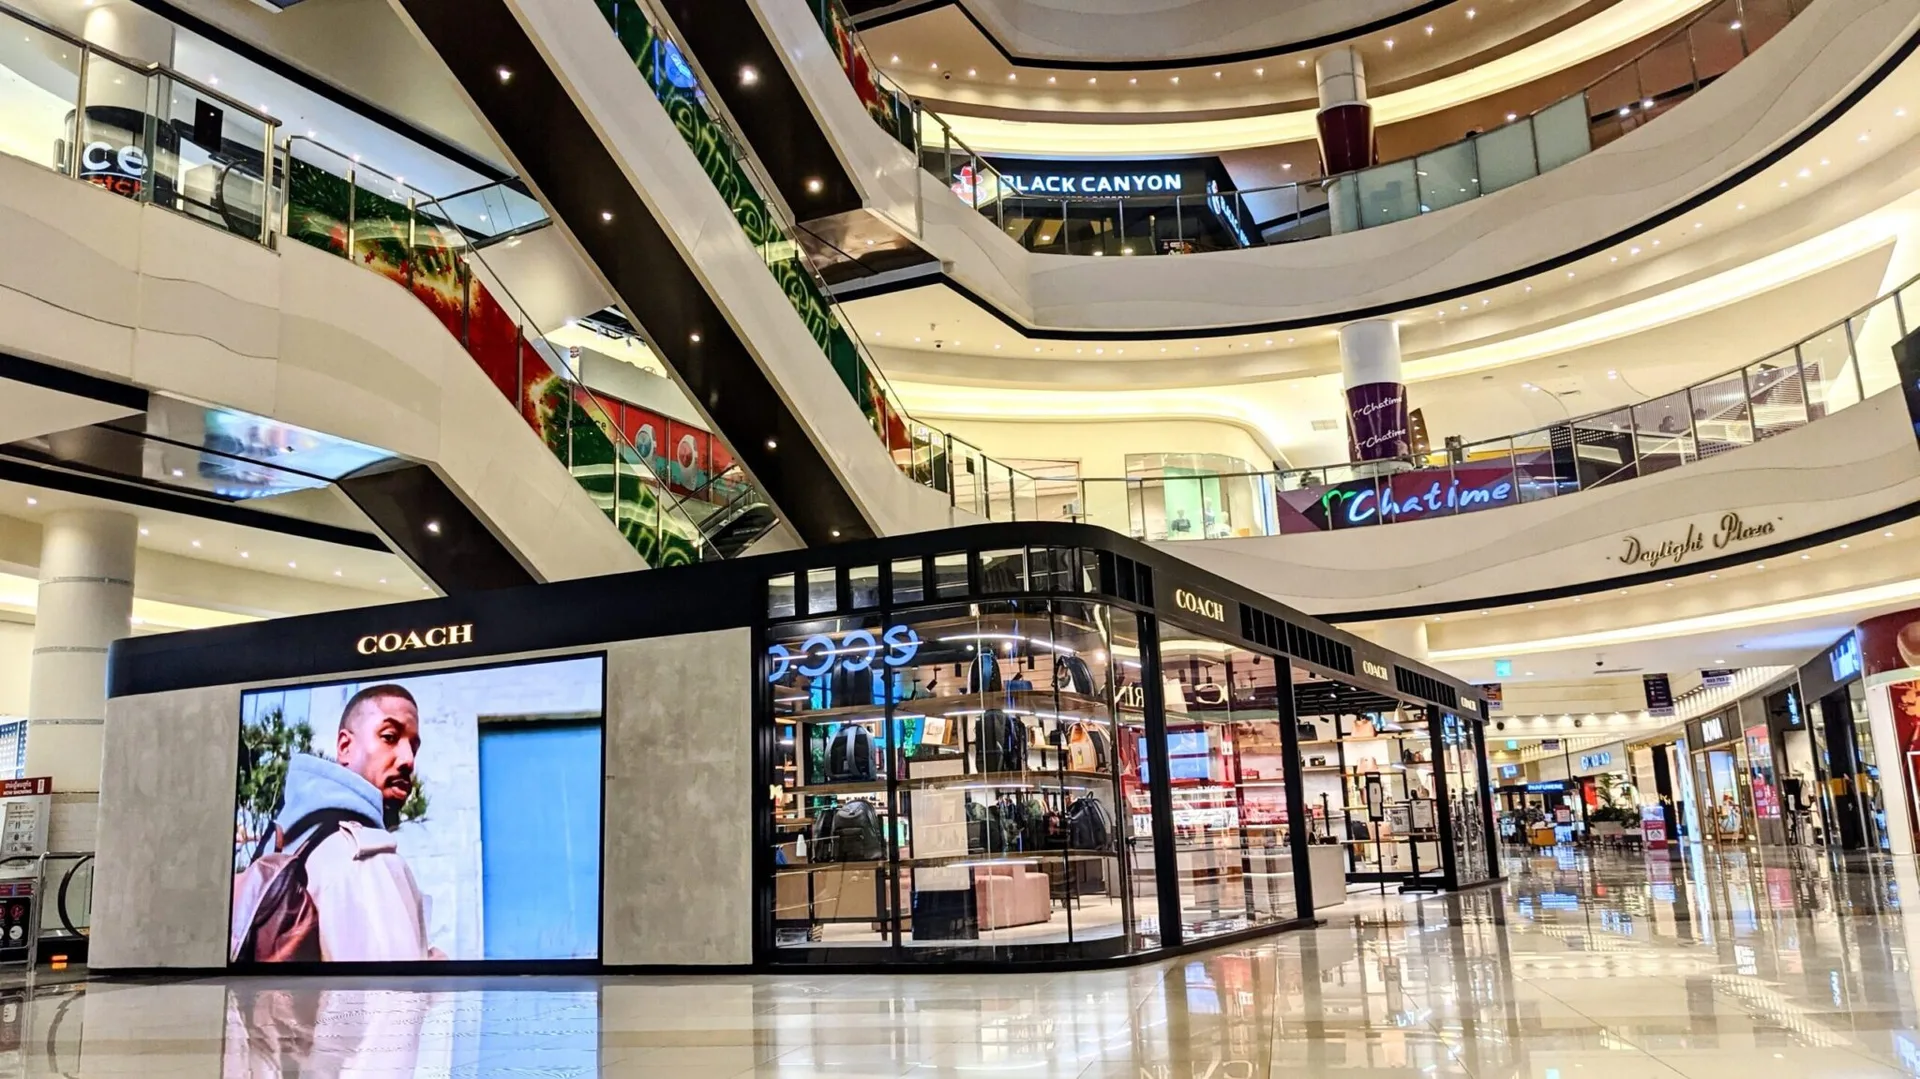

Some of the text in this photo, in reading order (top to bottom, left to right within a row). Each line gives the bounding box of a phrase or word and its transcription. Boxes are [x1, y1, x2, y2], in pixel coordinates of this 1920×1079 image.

[1000, 174, 1181, 193] BLACK CANYON
[1362, 396, 1402, 416] Chatime
[1366, 428, 1407, 448] Chatime
[1349, 479, 1511, 522] Chatime
[1619, 512, 1775, 568] Daylight Plaza
[1175, 588, 1225, 623] COACH
[357, 623, 473, 655] COACH
[1362, 660, 1388, 681] COACH
